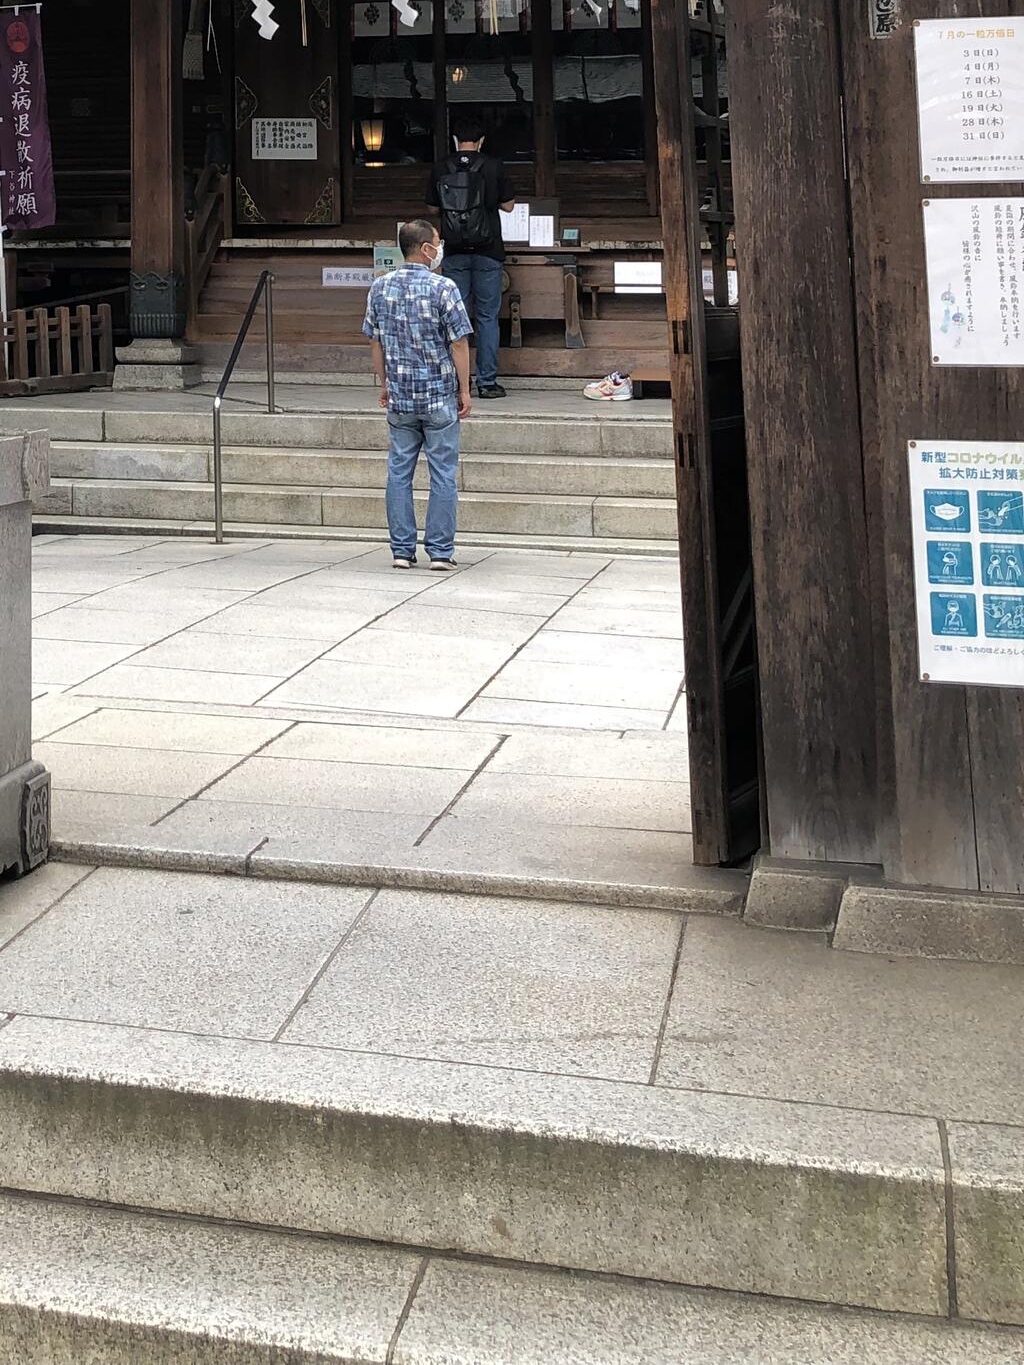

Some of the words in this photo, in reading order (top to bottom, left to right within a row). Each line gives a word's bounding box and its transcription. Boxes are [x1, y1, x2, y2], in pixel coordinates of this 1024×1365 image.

[10, 59, 39, 216] 疫病退散祈願
[921, 450, 1024, 465] 新型コロナウイル
